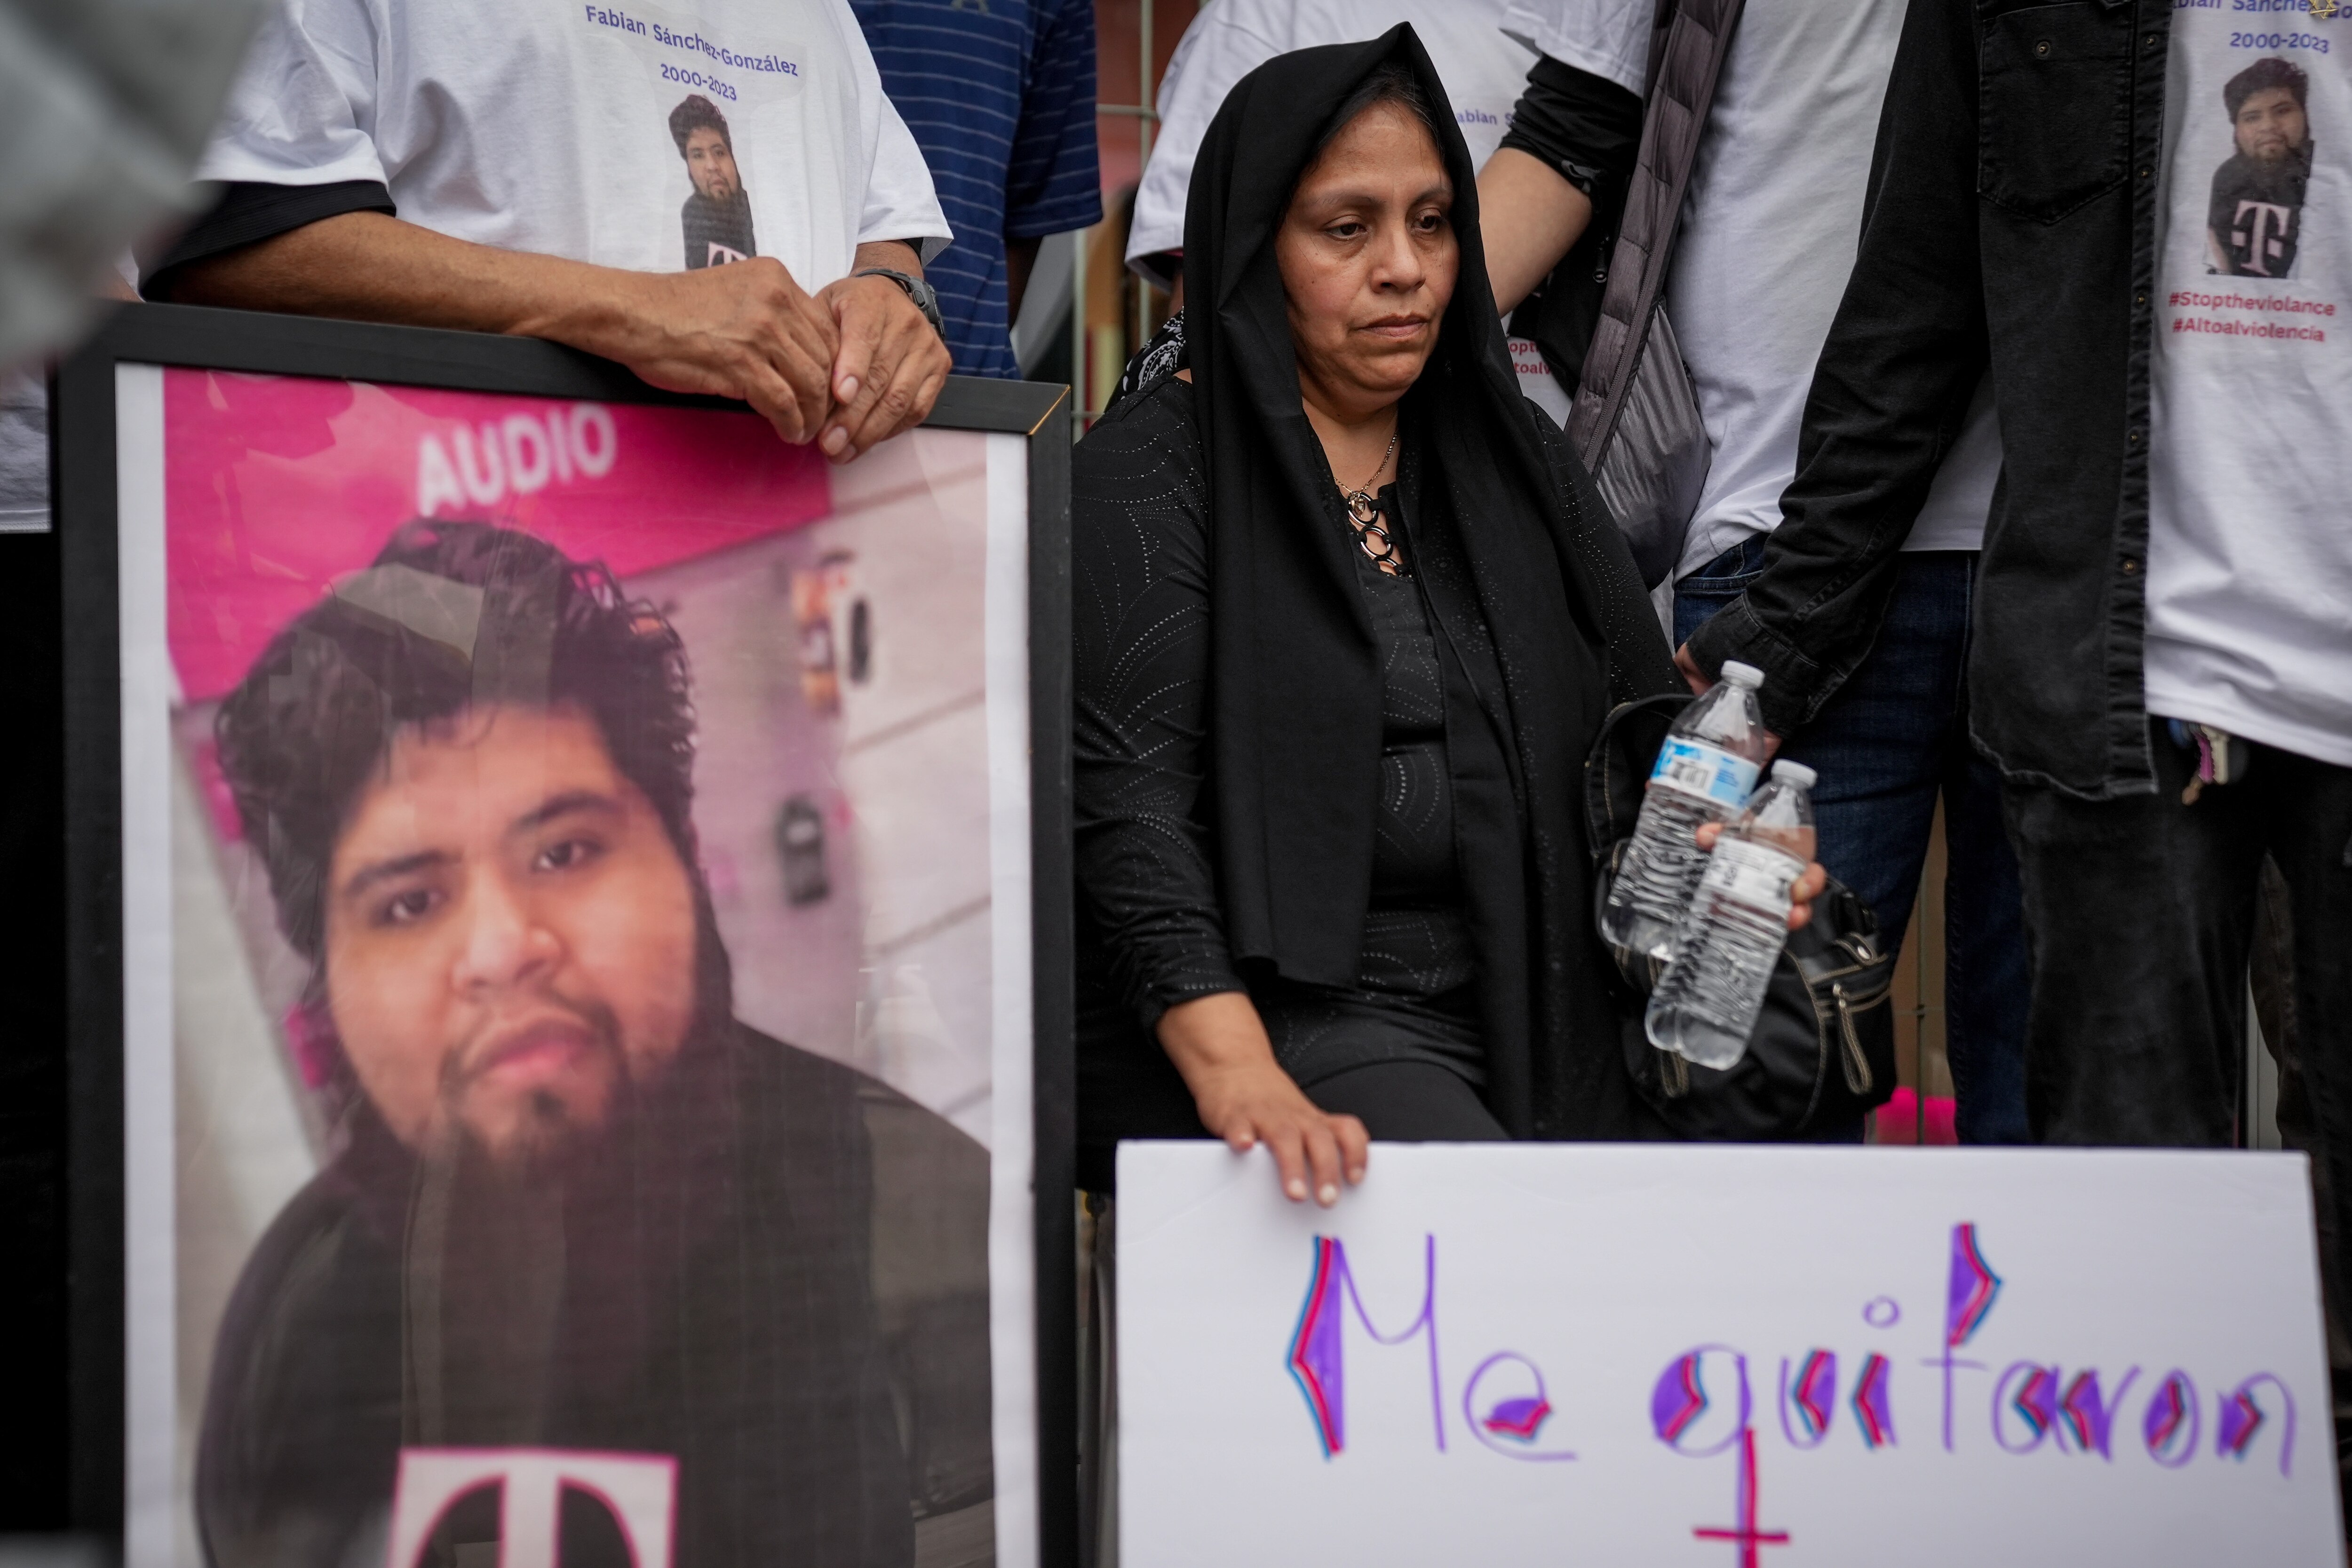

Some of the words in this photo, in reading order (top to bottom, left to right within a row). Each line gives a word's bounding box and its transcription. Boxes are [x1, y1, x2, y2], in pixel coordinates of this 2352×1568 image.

[585, 5, 646, 36] Fabian
[653, 24, 798, 77] Sánchez-González
[2230, 32, 2329, 54] 2000-2023
[660, 63, 737, 101] 2000-2023
[1456, 109, 1497, 125] abian
[2169, 291, 2336, 316] #Stoptheviolance
[2172, 317, 2325, 342] #Altoalviolencia
[418, 401, 617, 517] AUDIO
[1287, 1233, 1579, 1463] Me
[1650, 1220, 2298, 1568] quitaron
